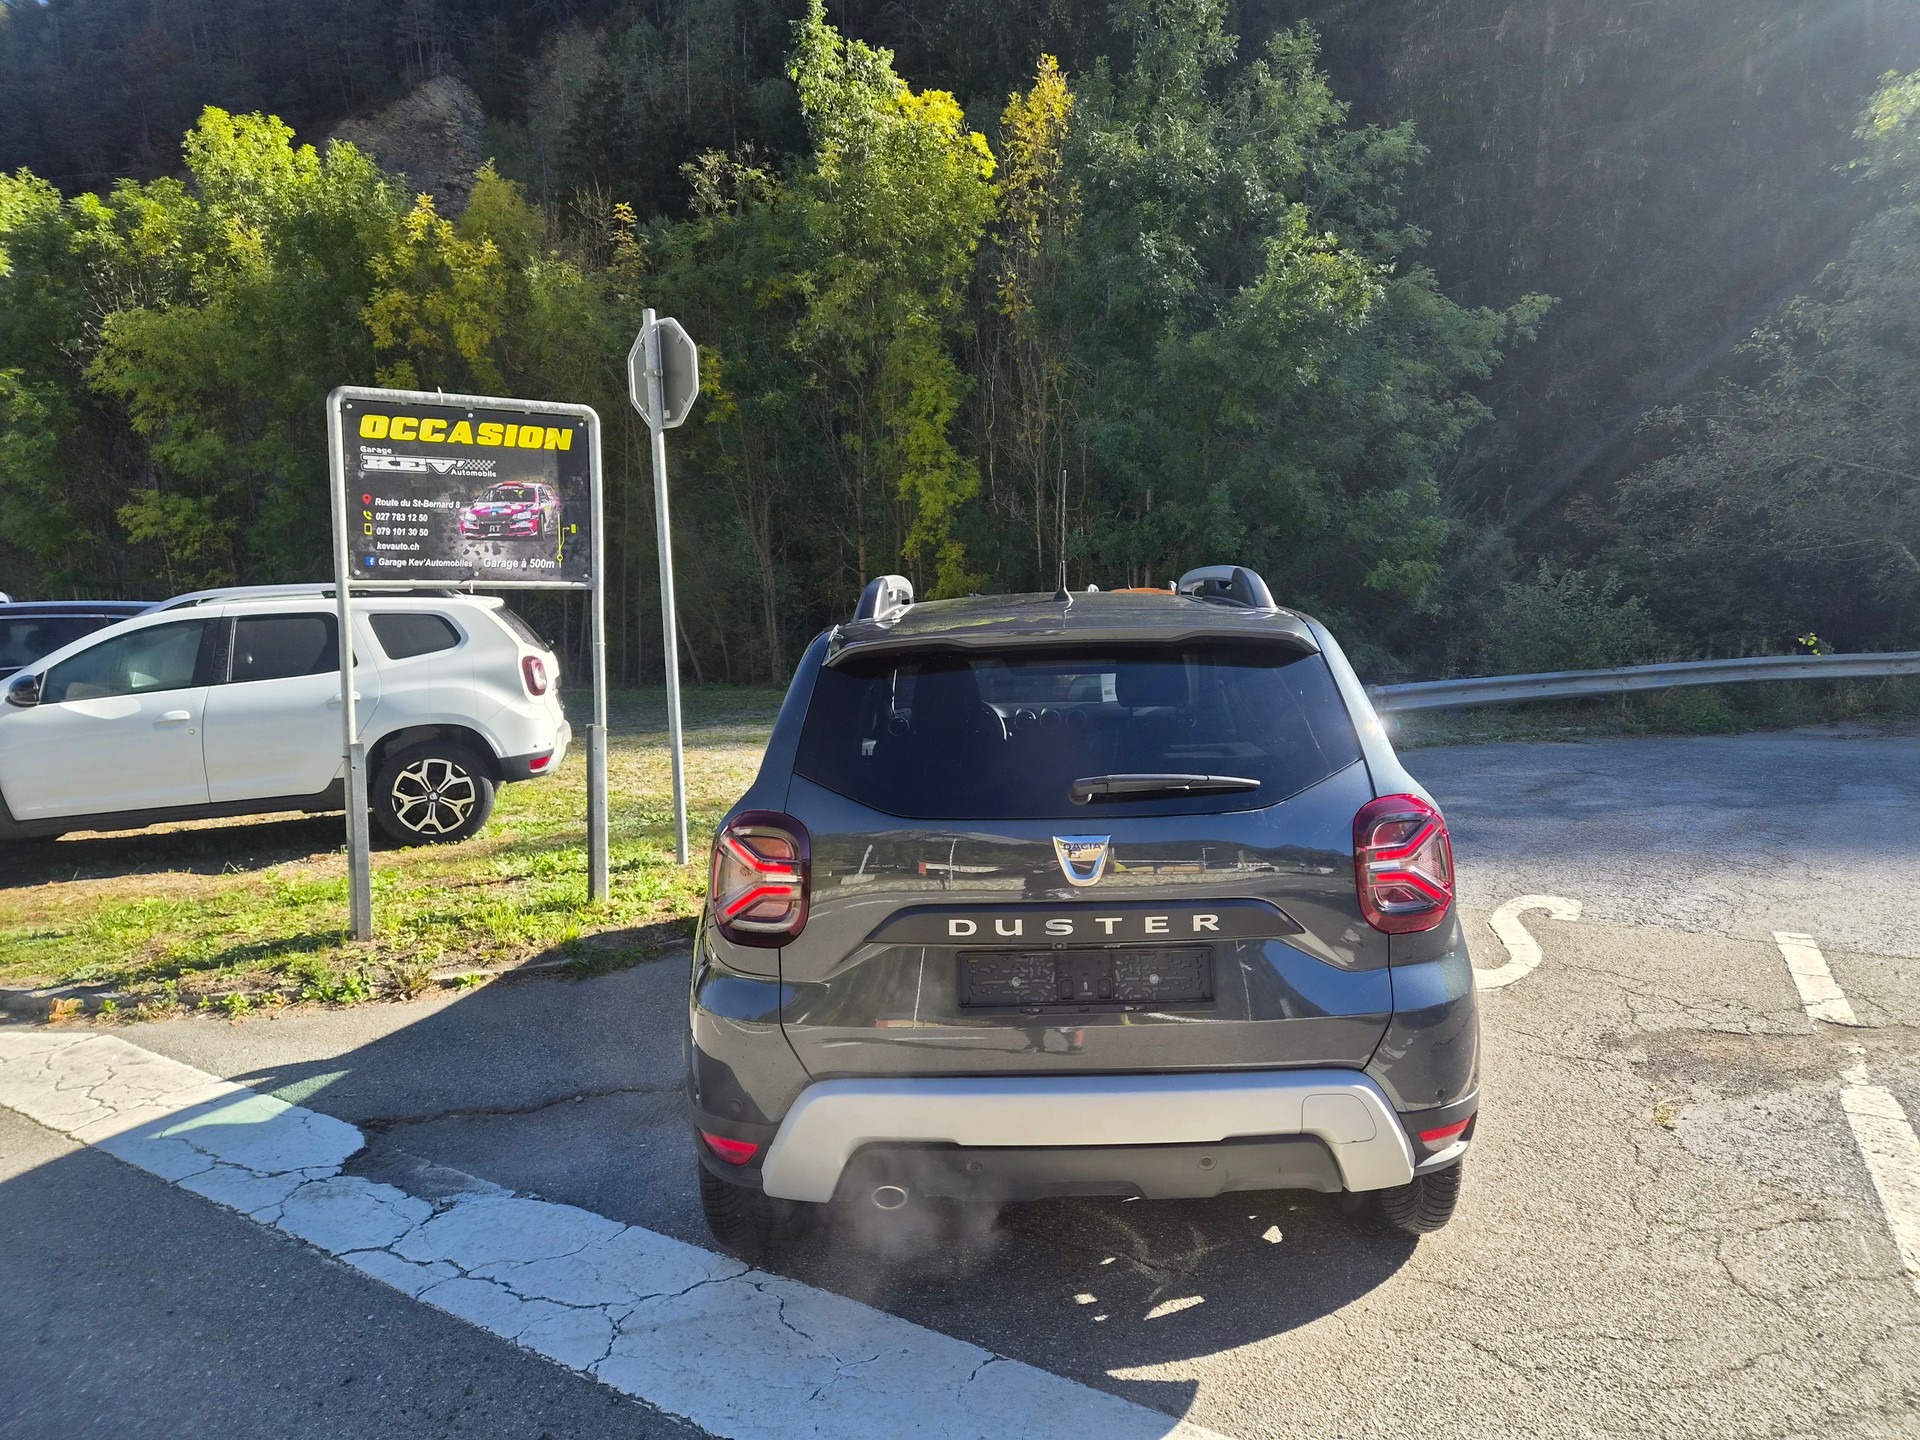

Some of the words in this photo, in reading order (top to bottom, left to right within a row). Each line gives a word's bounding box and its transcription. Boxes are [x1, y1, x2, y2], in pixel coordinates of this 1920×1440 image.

[359, 414, 573, 450] OCCASION
[360, 446, 392, 455] Garage
[451, 469, 497, 477] Automobile
[375, 498, 399, 507] Route
[400, 499, 411, 507] du
[412, 499, 454, 509] St-Bernard
[375, 513, 390, 521] 027
[392, 513, 406, 521] 783
[407, 513, 417, 522] 12
[418, 514, 428, 522] 50
[376, 527, 391, 535] 079
[392, 528, 406, 536] 101
[408, 528, 418, 536] 30
[419, 528, 429, 536] 50
[376, 542, 420, 550] kevauto.ch
[378, 558, 407, 568] Garage
[484, 558, 519, 570] Garage
[520, 558, 527, 568] à
[529, 559, 555, 569] 500m
[948, 914, 1220, 937] DUSTER
